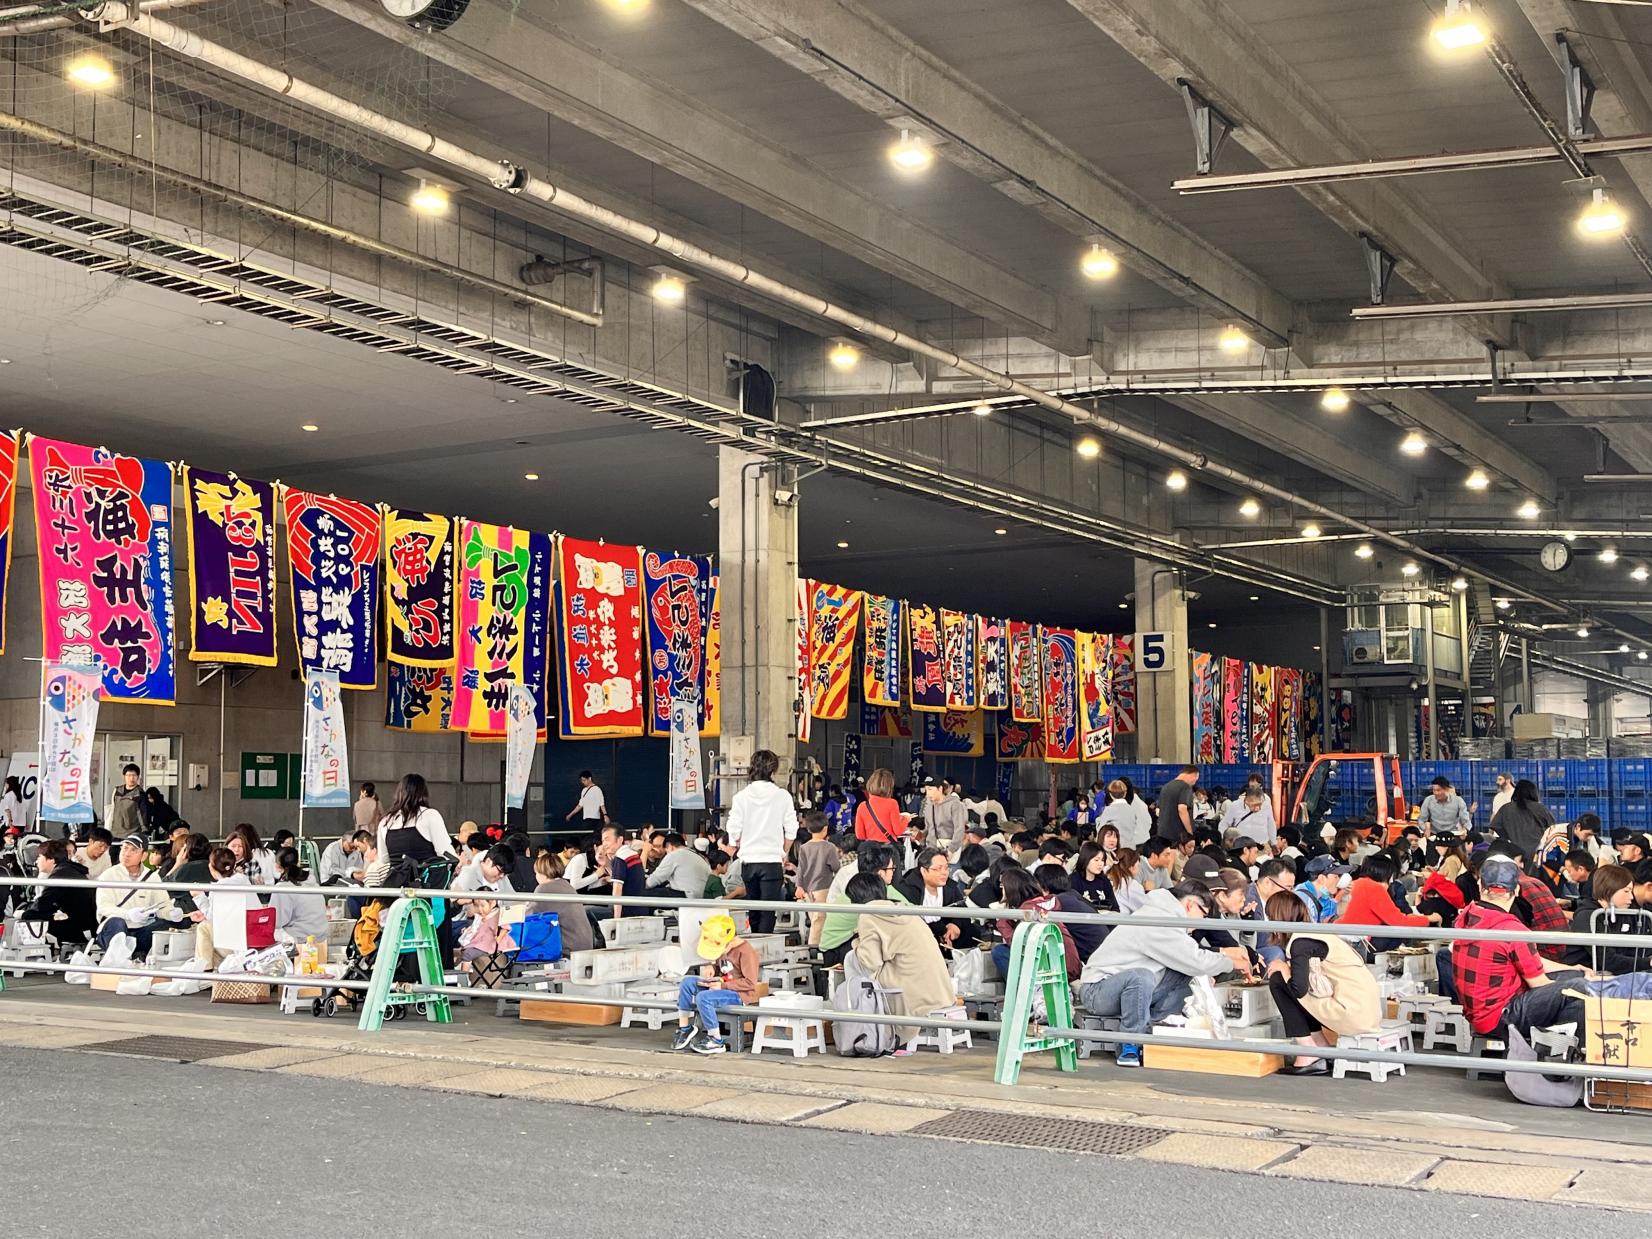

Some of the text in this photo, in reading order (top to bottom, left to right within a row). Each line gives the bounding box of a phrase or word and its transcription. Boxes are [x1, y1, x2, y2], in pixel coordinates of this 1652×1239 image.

[1143, 634, 1165, 668] 5
[58, 715, 86, 801] さかなの日
[320, 716, 340, 788] さかなの日
